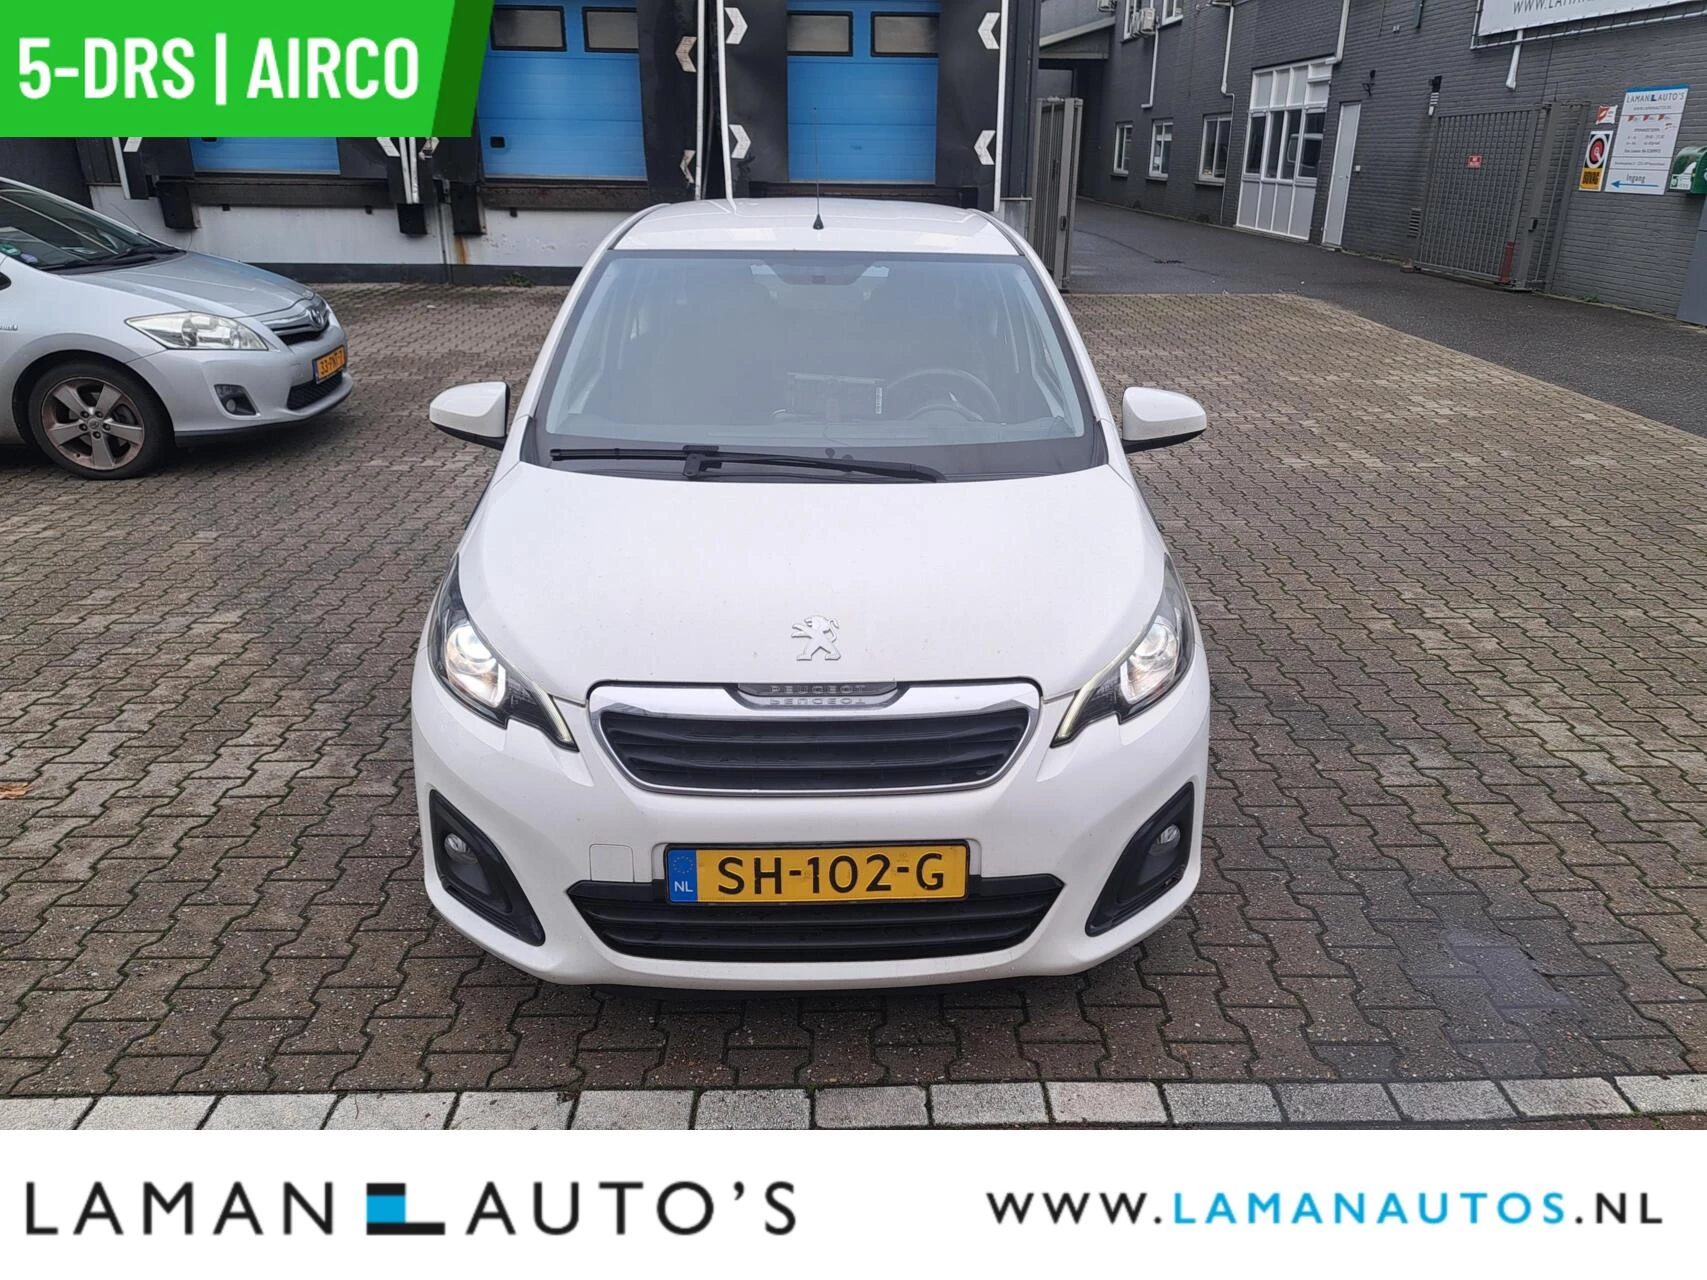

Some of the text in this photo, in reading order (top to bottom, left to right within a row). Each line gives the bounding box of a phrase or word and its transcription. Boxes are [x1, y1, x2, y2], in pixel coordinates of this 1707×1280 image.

[1626, 94, 1650, 103] LAMAN
[1658, 92, 1685, 102] AUTO'S
[1626, 173, 1646, 184] Ingang
[769, 685, 867, 694] PEUGEOT
[718, 852, 944, 895] SH-102-G
[673, 881, 694, 893] NL
